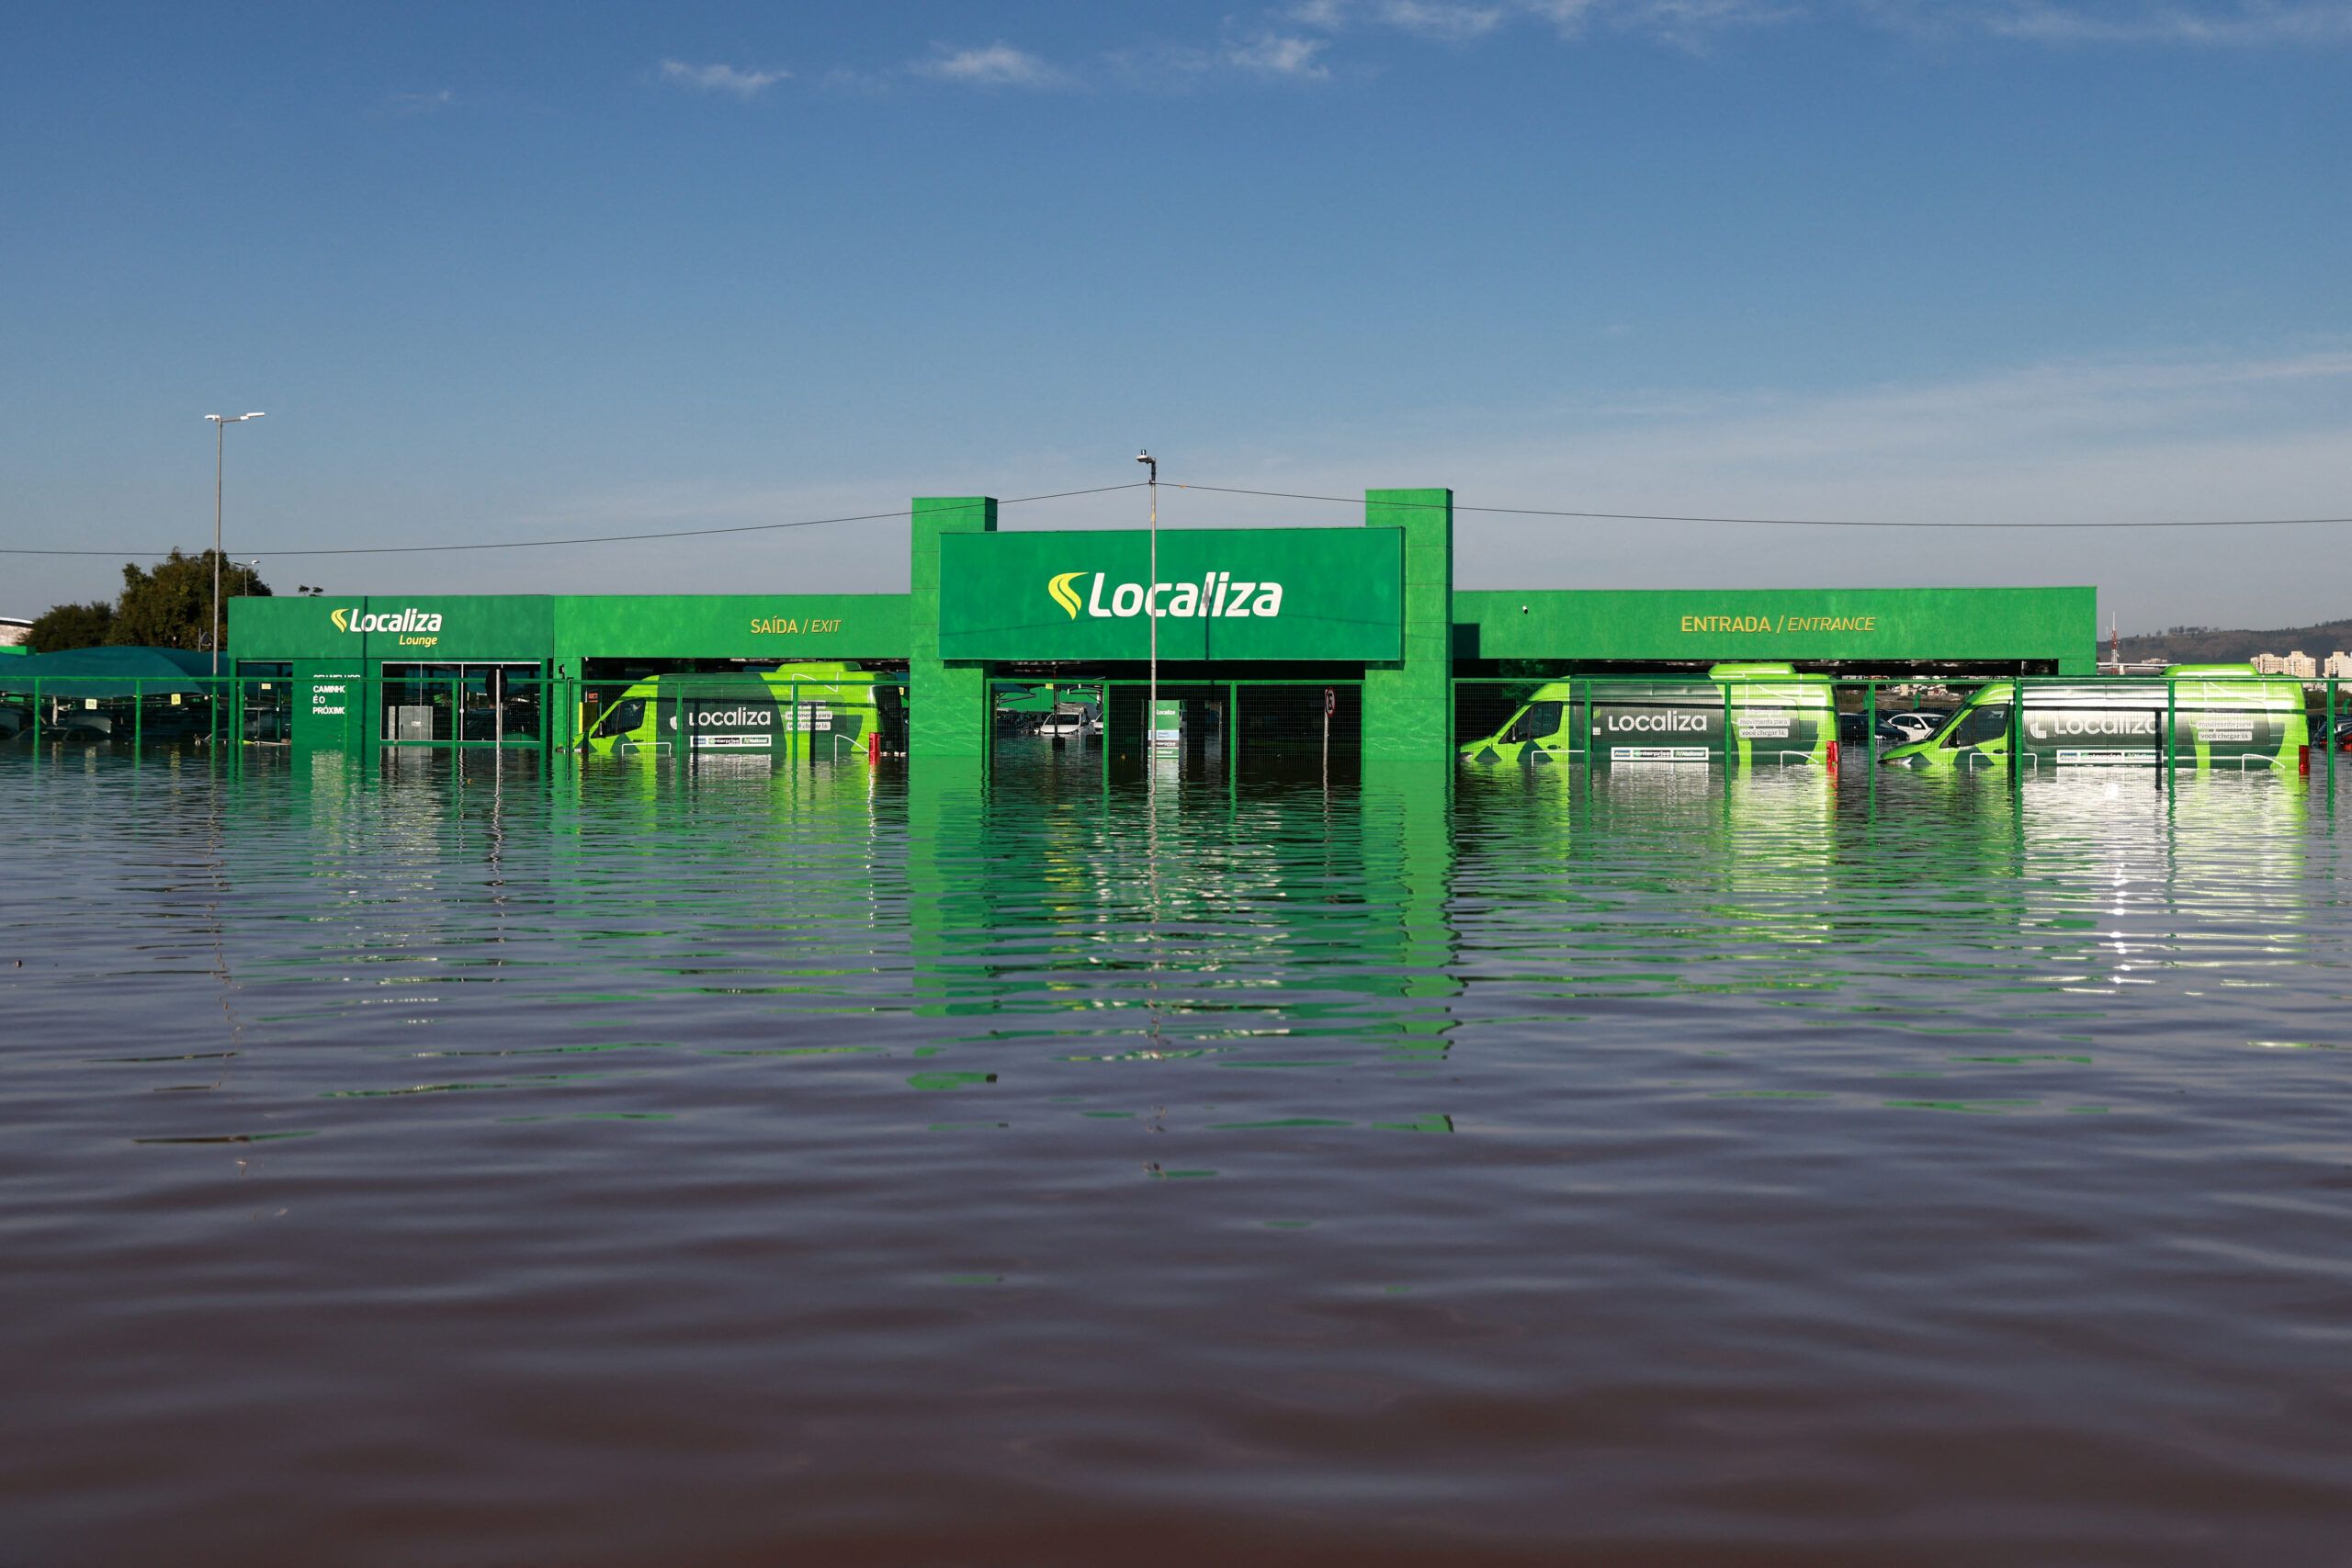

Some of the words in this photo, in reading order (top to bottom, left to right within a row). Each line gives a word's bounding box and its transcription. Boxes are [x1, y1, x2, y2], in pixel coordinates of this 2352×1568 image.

[1088, 572, 1283, 617] Localiza
[350, 608, 443, 632] Localiza
[751, 615, 798, 635] SAÍDA
[810, 619, 842, 633] EXIT
[1680, 616, 1771, 633] ENTRADA
[1787, 617, 1876, 632] ENTRANCE
[399, 635, 438, 648] Lounge
[312, 694, 319, 705] É
[318, 695, 326, 705] O
[689, 706, 771, 726] Localiza
[1608, 710, 1707, 731] Localiza
